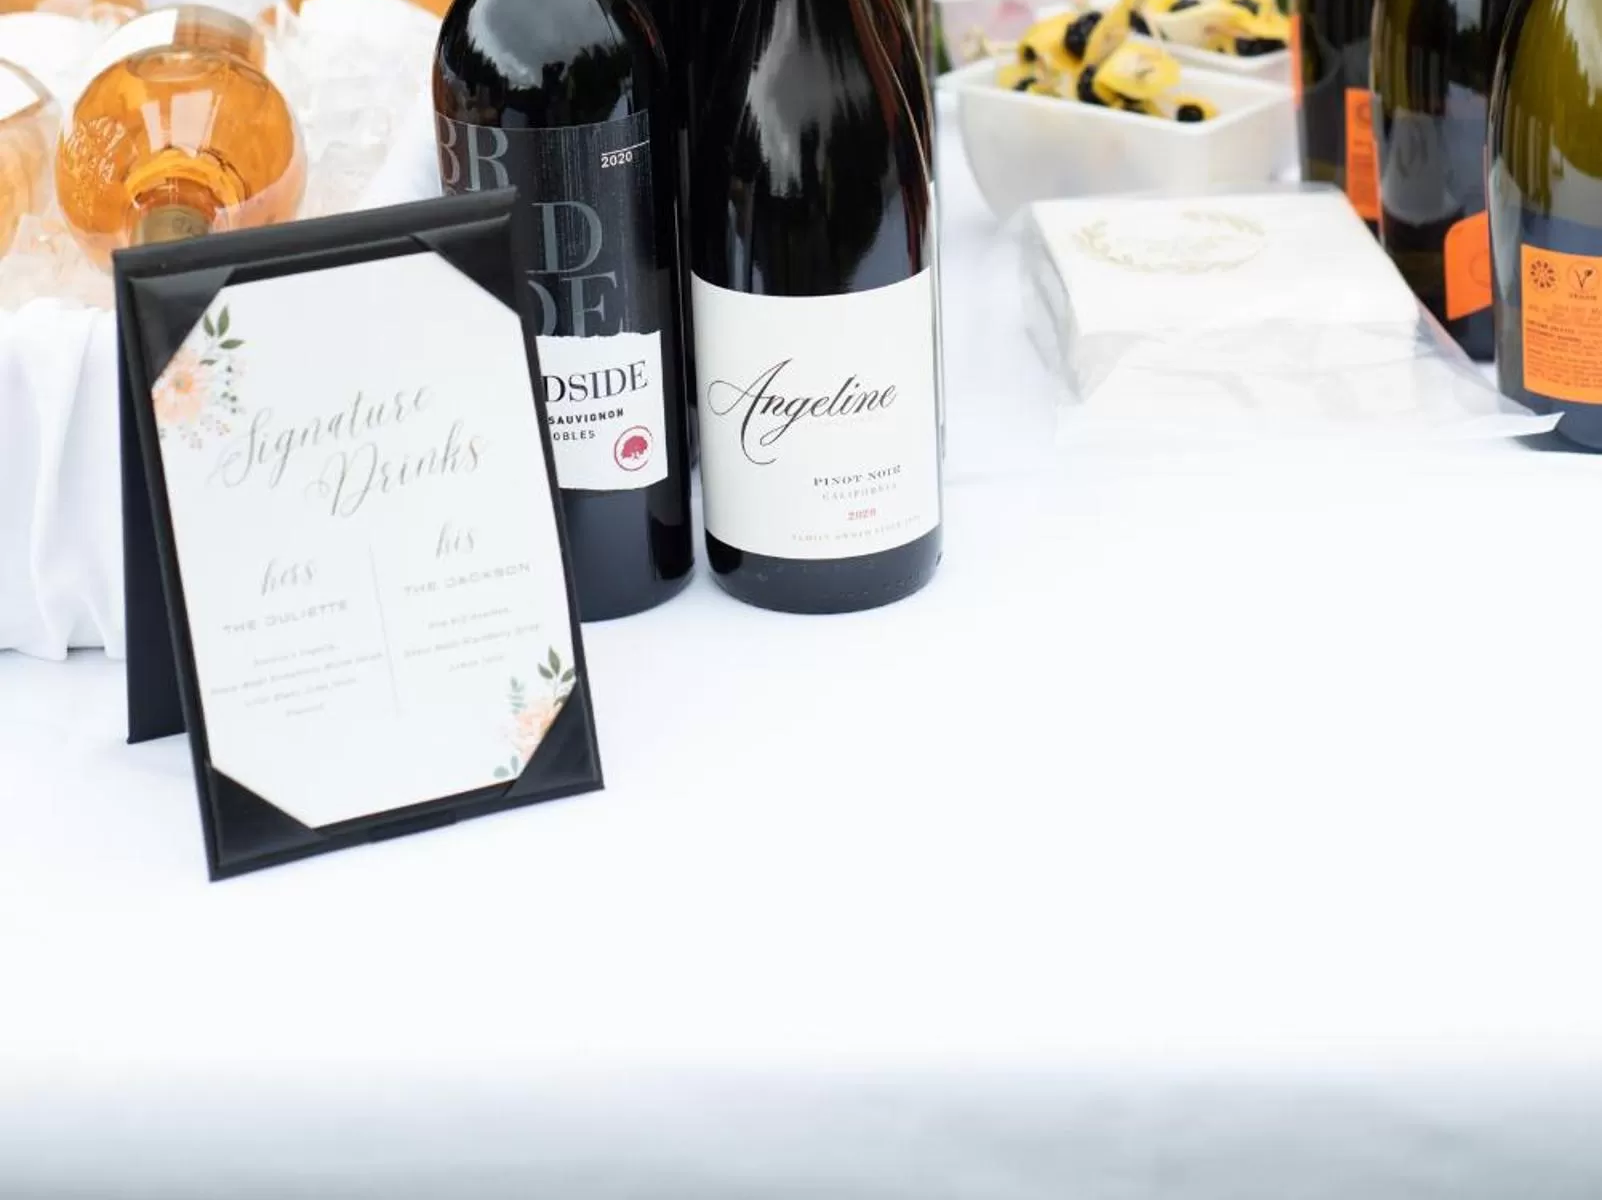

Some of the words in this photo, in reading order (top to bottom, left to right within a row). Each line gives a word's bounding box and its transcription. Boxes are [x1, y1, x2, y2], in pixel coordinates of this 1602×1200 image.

[601, 151, 633, 169] 2020
[206, 385, 432, 490] Signature
[547, 408, 624, 425] SAUVIGNON
[707, 358, 896, 465] Angeline
[304, 419, 486, 518] Drinks
[814, 474, 863, 487] PINOT
[867, 464, 901, 480] NOIR
